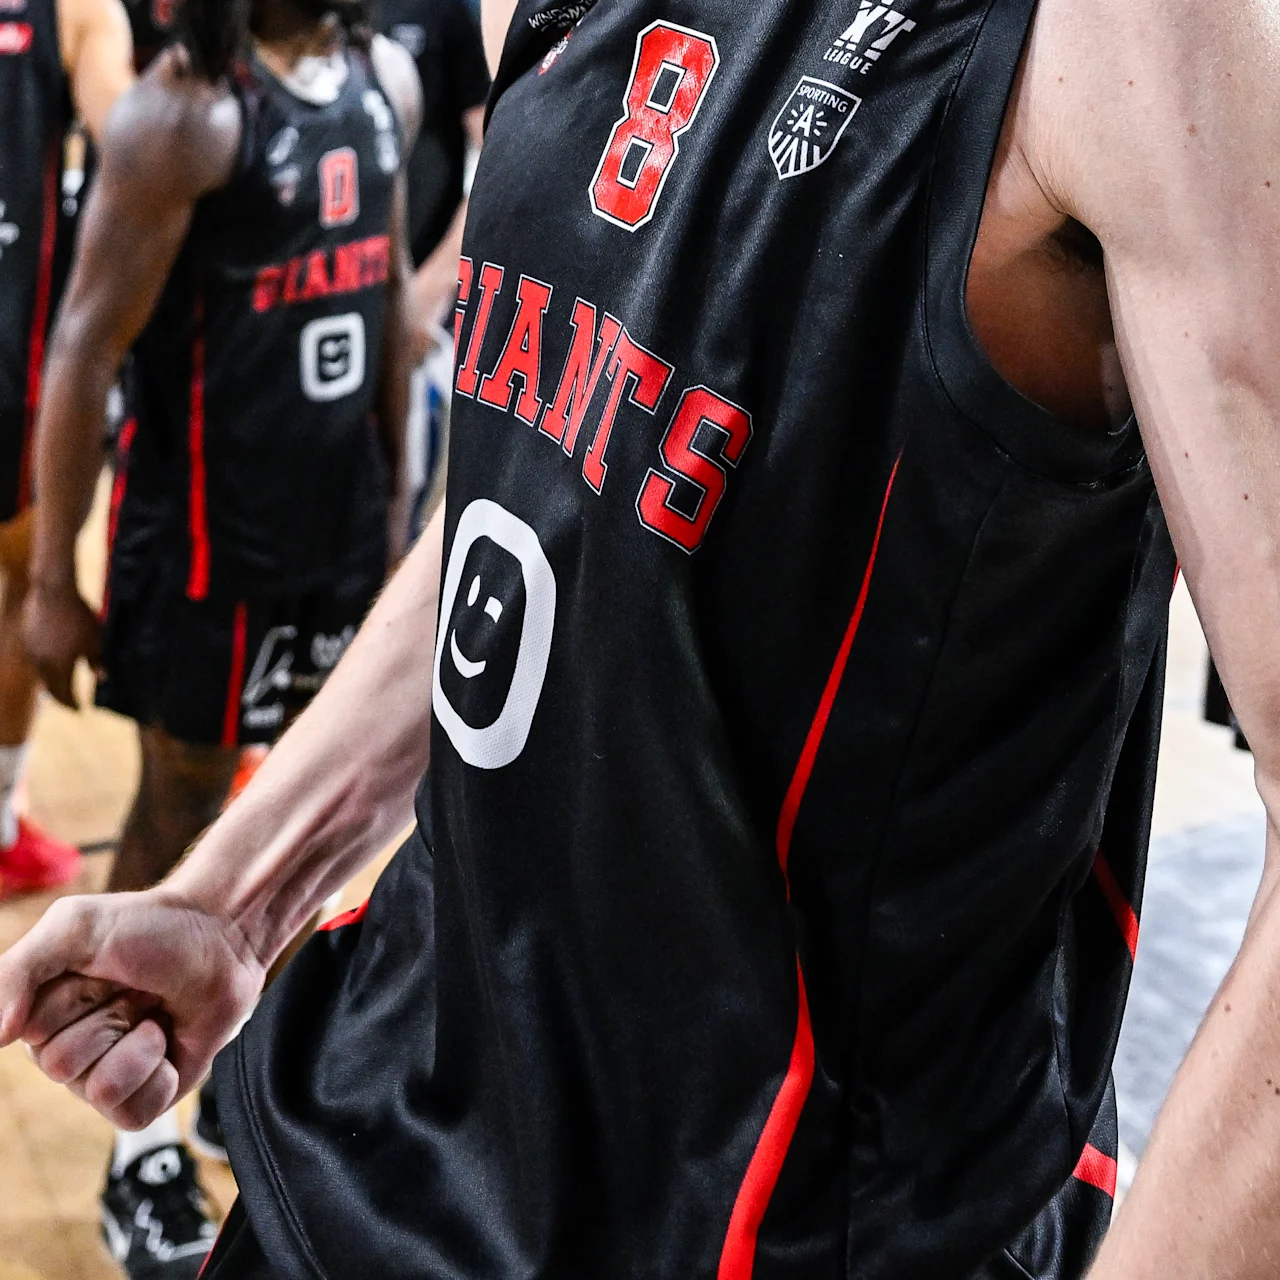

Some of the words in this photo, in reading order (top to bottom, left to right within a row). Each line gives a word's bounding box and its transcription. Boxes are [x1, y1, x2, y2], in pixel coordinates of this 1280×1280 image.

[823, 47, 873, 74] LEAGUE
[797, 84, 848, 113] SPORTING
[588, 19, 720, 232] 8
